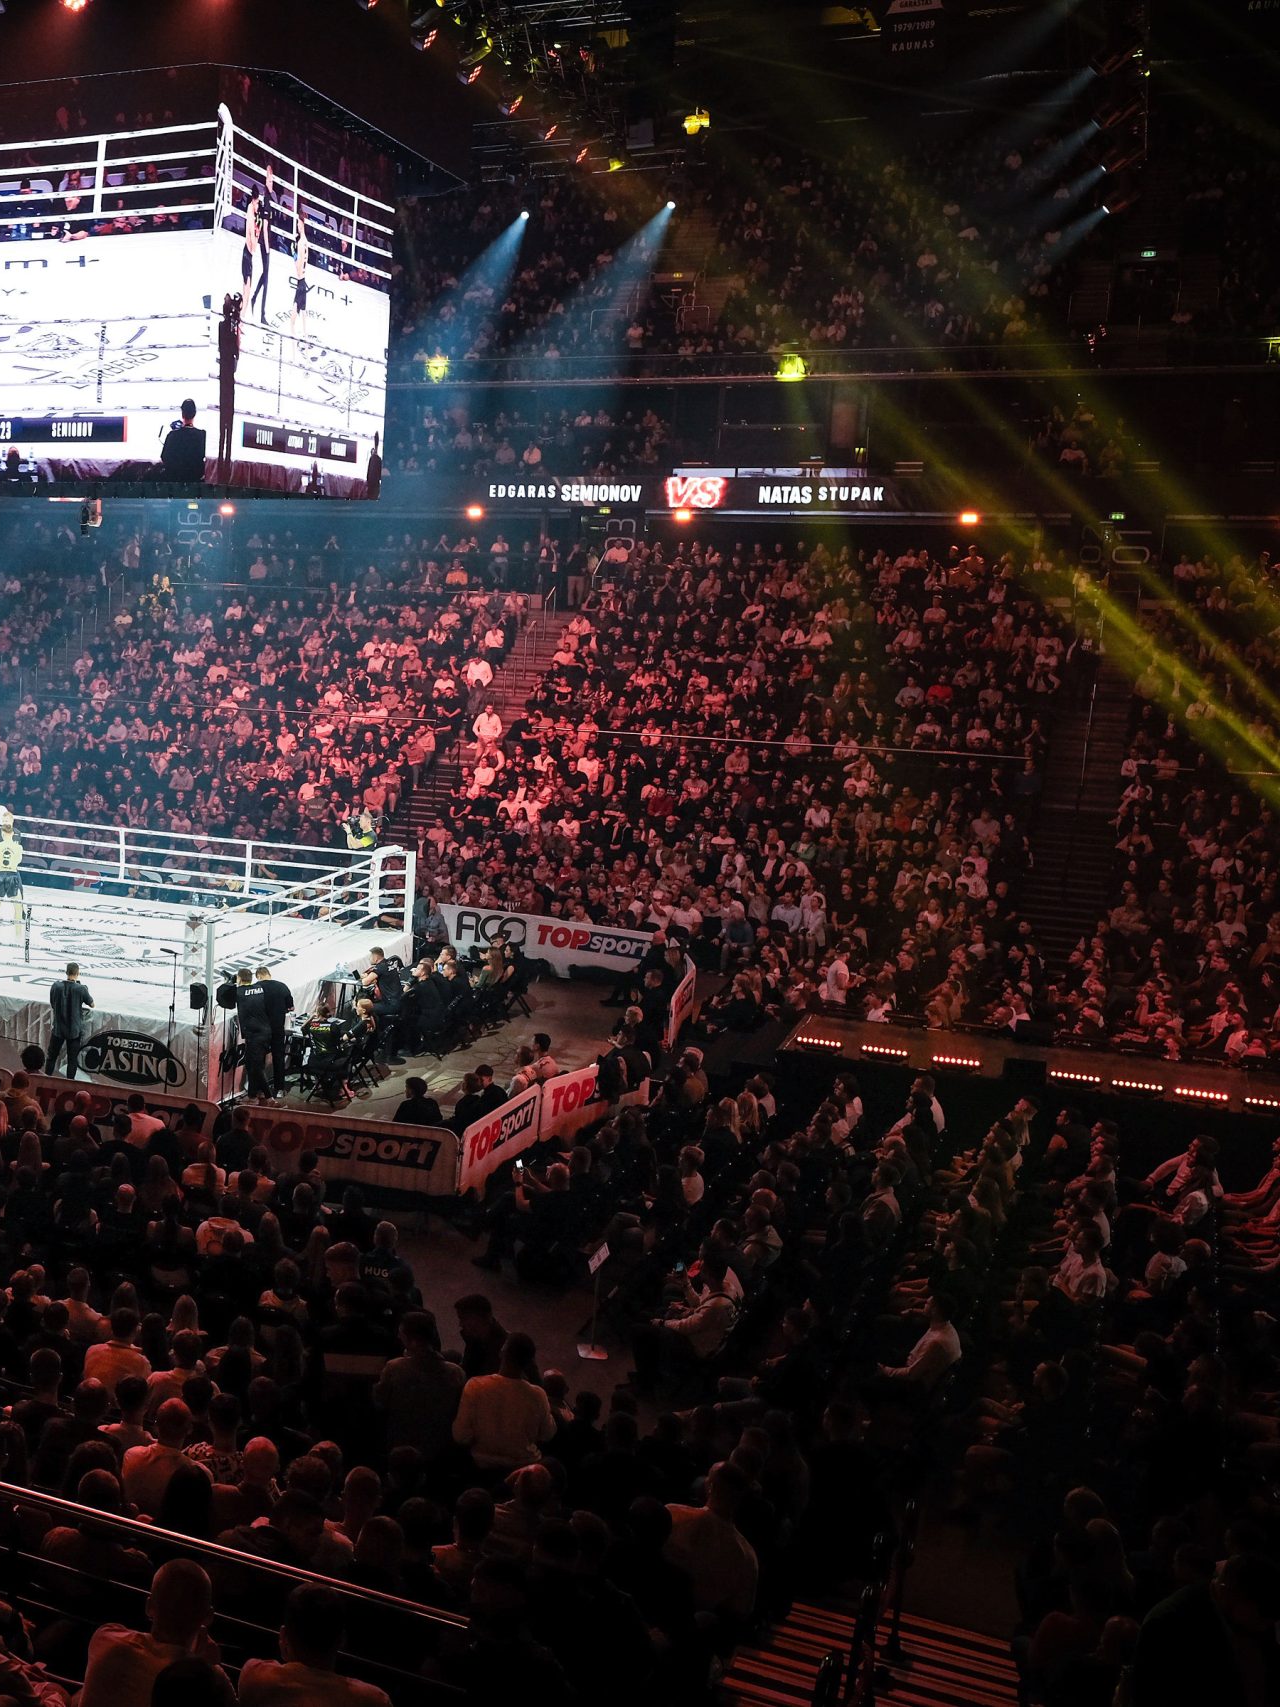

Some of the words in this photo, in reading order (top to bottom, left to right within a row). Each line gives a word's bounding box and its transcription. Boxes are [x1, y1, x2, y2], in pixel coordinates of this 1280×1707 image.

[891, 39, 935, 52] KAUNAS
[489, 485, 556, 499] EDGARAS
[561, 485, 641, 502] SEMIONOV
[666, 477, 726, 508] VS
[758, 486, 812, 504] NATAS
[818, 486, 884, 501] STUPAK
[537, 924, 651, 961] TOPsport
[107, 1036, 153, 1051] TOPsport
[77, 1046, 184, 1086] CASINO
[469, 1099, 535, 1169] TOPsport
